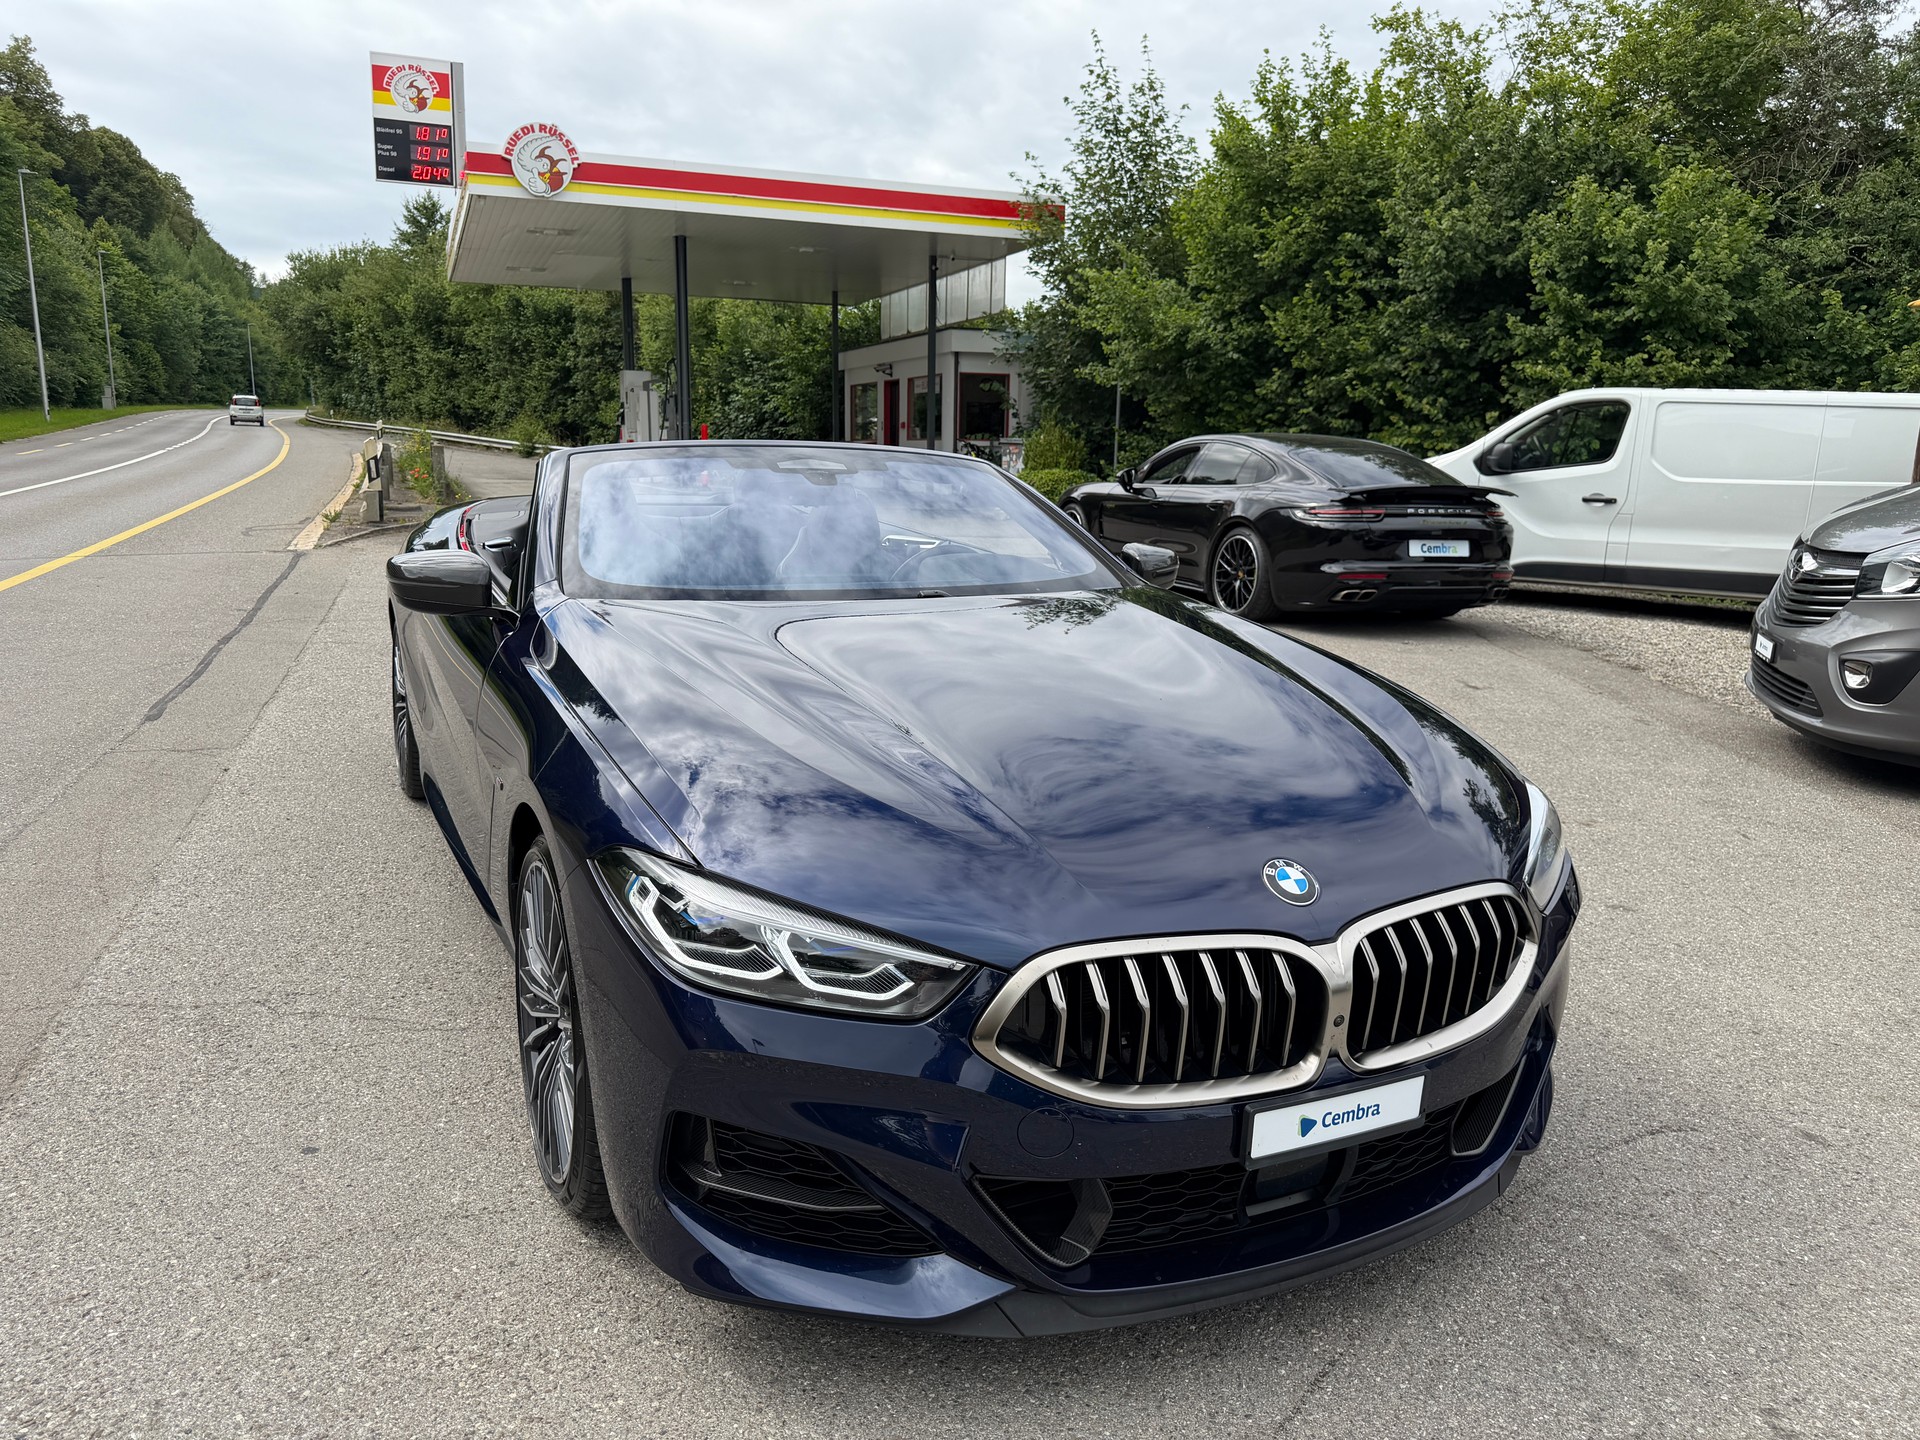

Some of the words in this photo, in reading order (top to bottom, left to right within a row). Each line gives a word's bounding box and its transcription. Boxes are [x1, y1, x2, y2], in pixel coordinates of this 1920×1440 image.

[385, 64, 406, 88] RUEDI
[408, 64, 438, 92] RÜSSEL
[376, 126, 395, 134] Bleifrei
[377, 142, 393, 150] Super
[504, 124, 535, 157] RUEDI
[538, 123, 579, 165] RÜSSEL
[1420, 543, 1458, 554] Cembra
[1266, 860, 1303, 876] BMW
[1321, 1103, 1380, 1128] Cembra
